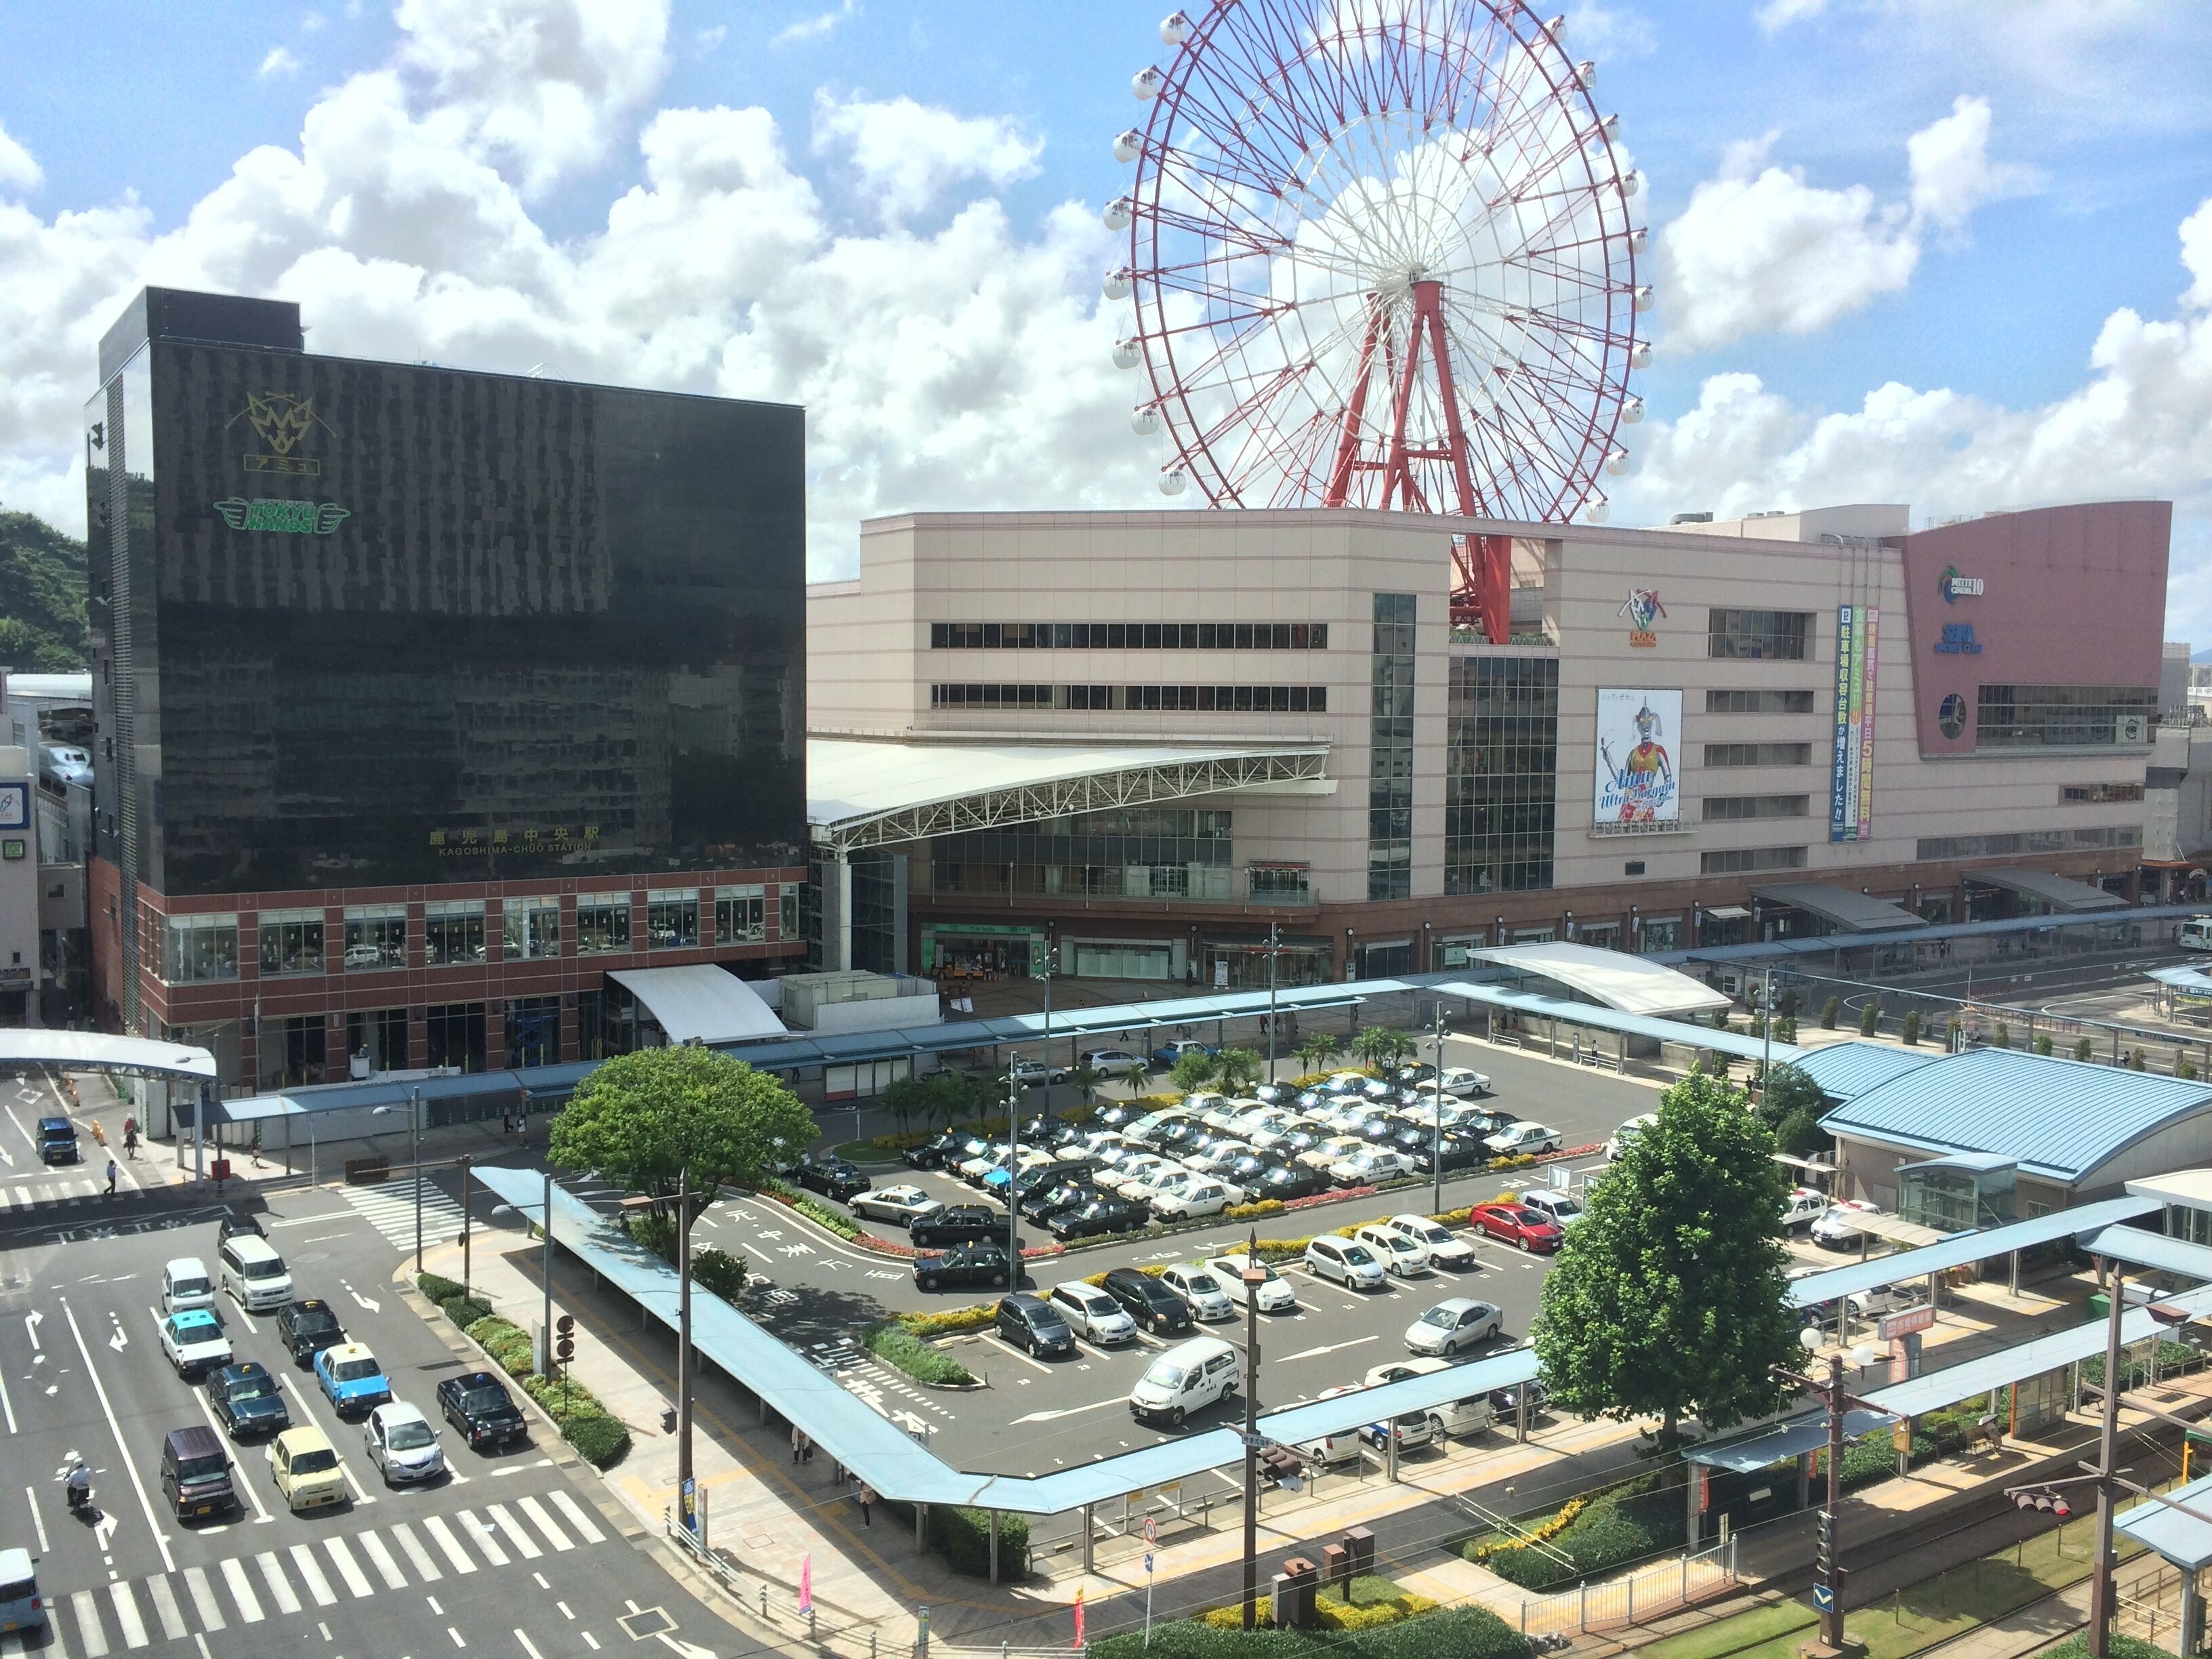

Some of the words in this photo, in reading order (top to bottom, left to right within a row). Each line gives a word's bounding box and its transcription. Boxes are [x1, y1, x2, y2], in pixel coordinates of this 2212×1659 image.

[251, 502, 316, 519] TOKYU
[247, 516, 312, 533] HANDS
[429, 826, 599, 846] 鹿児島中央駅
[548, 842, 592, 853] STATION
